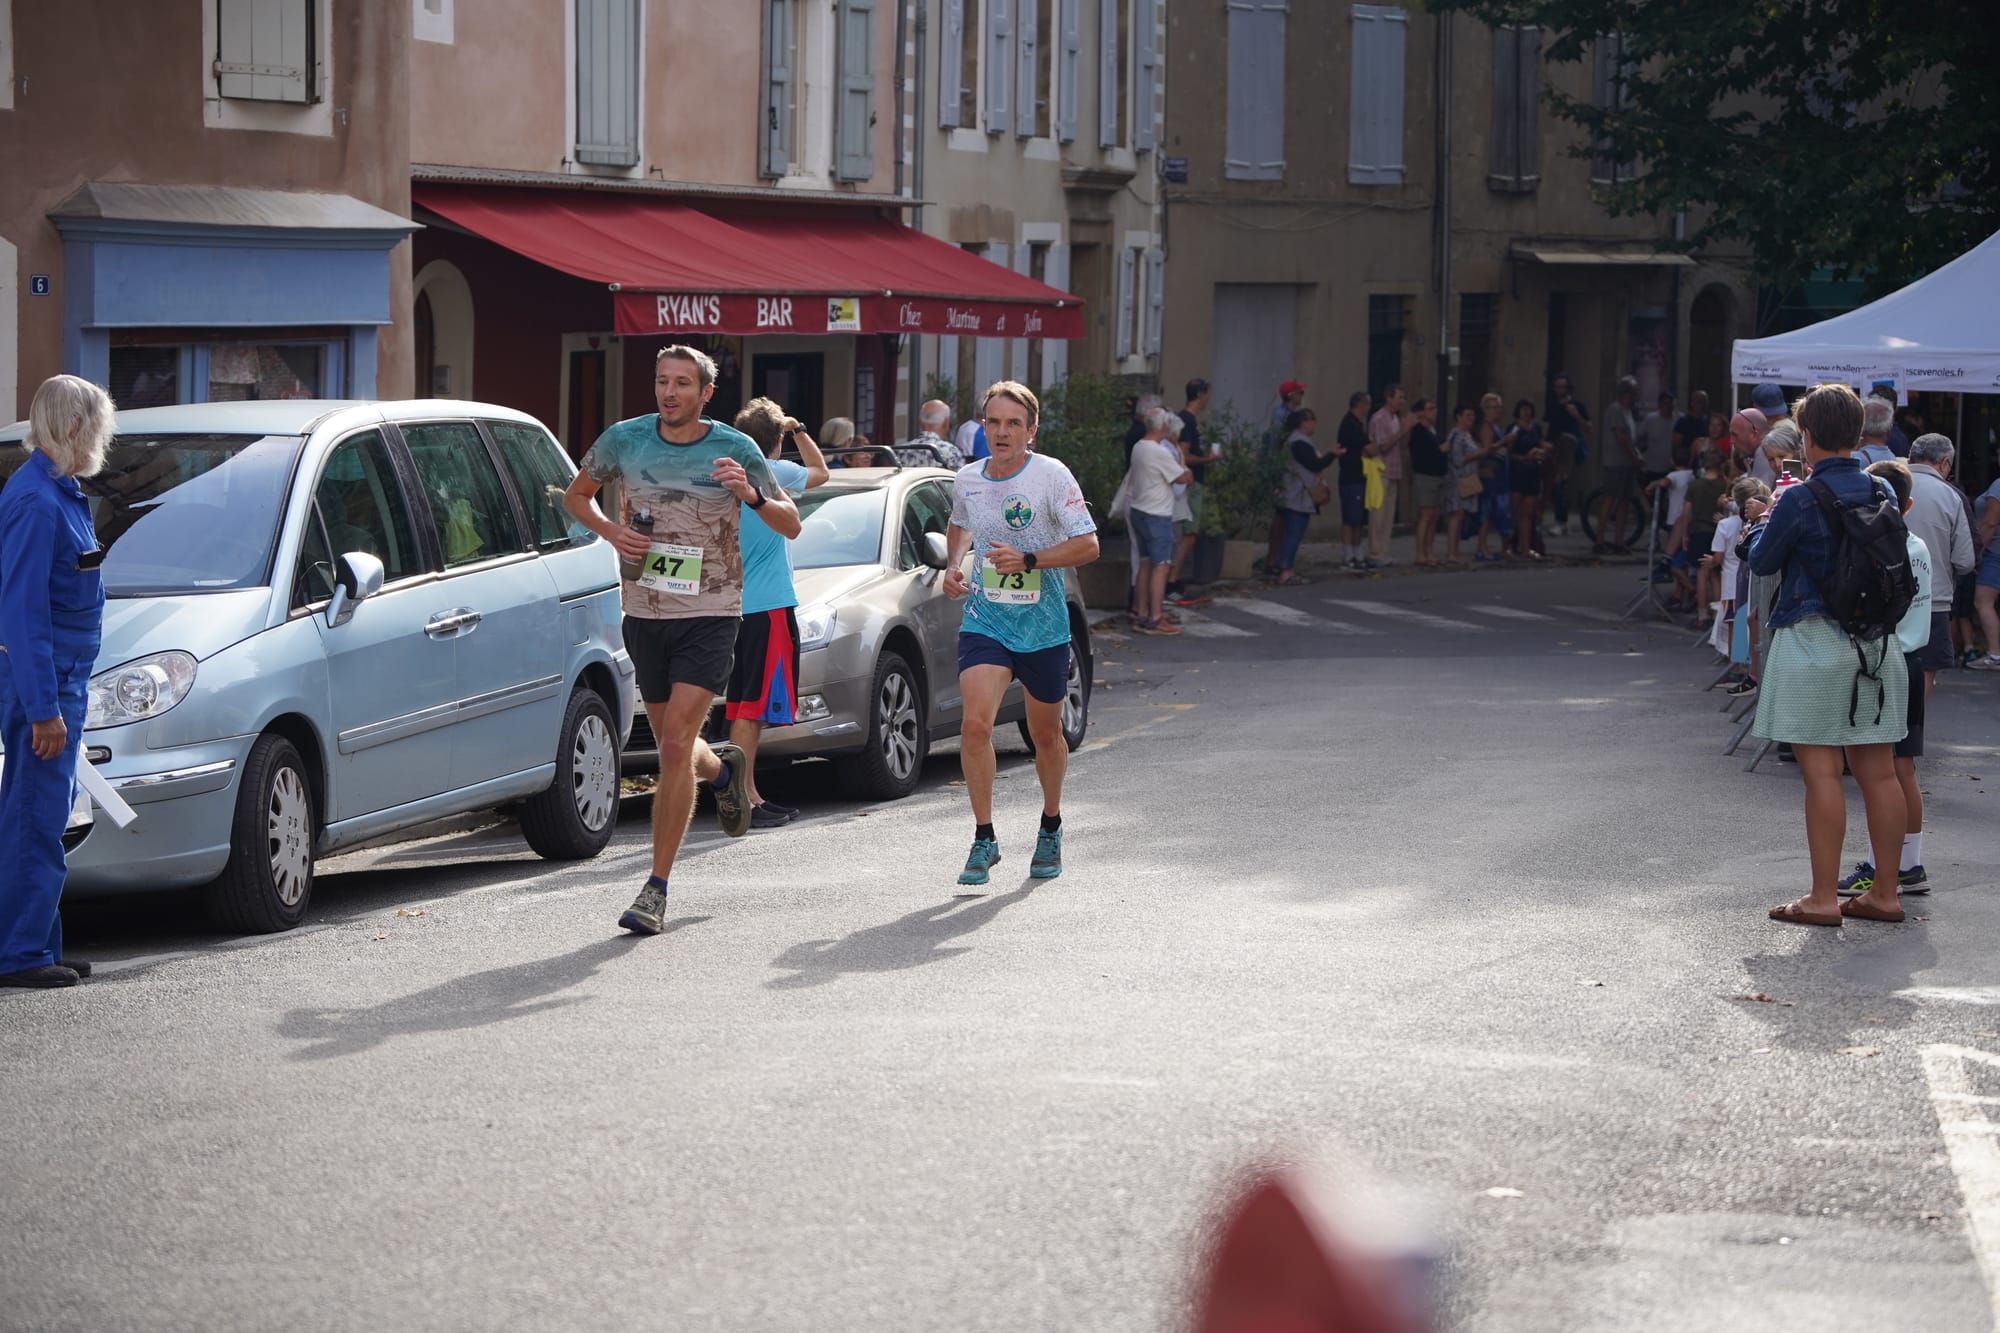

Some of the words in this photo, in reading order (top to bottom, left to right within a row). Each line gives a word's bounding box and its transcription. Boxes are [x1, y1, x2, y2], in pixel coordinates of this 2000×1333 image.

[37, 278, 44, 292] 6
[656, 295, 721, 326] RYAN'S
[756, 298, 793, 327] BAR
[900, 302, 922, 327] Chez
[945, 307, 981, 330] Martine
[997, 313, 1006, 331] et
[1023, 309, 1042, 336] John
[651, 556, 685, 577] 47
[999, 573, 1024, 589] 73
